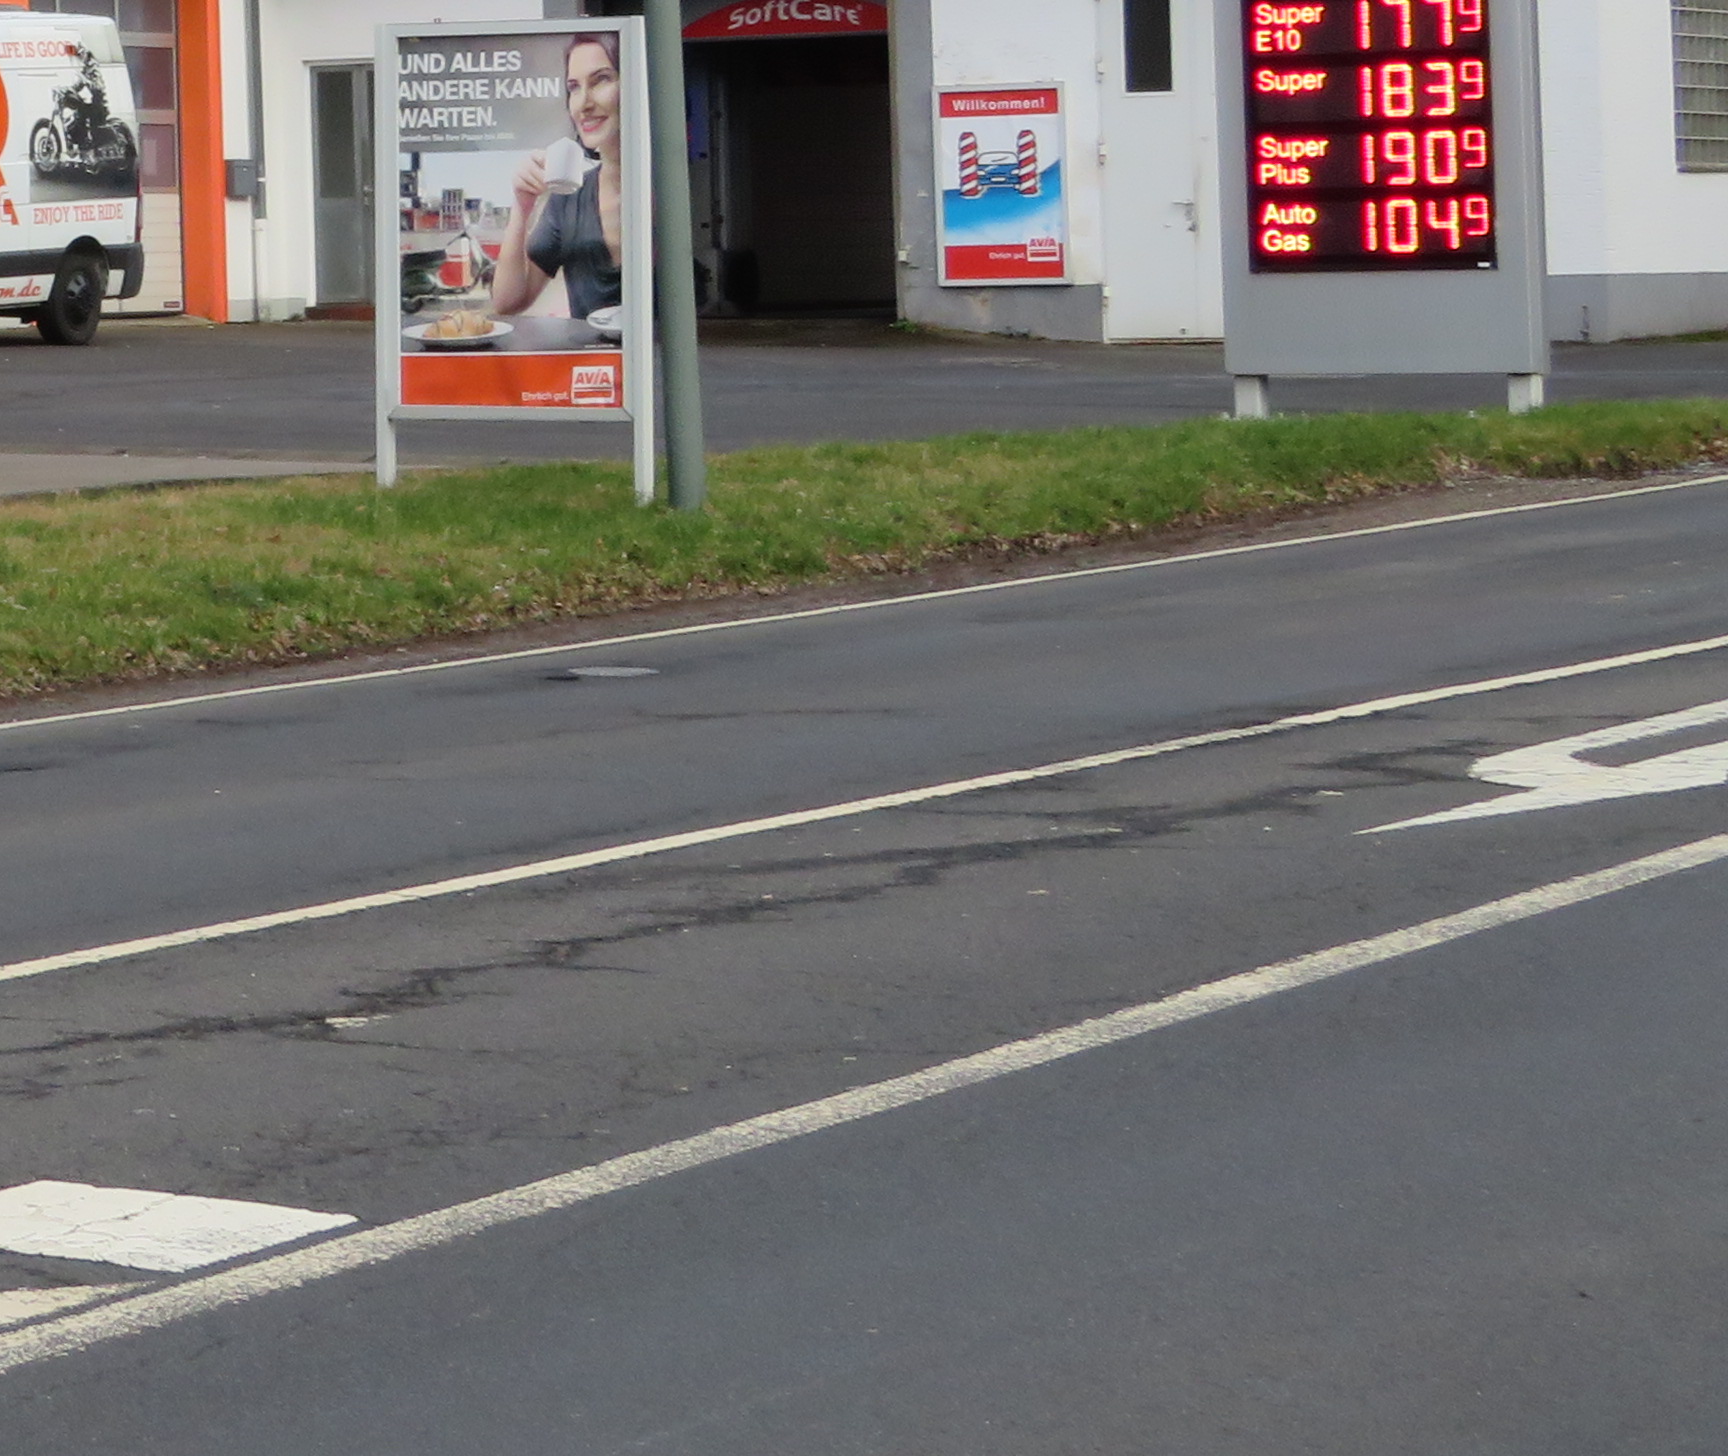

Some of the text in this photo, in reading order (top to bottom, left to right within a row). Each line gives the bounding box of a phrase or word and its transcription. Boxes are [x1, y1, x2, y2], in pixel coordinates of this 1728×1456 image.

[1254, 2, 1326, 29] Super
[24, 41, 36, 58] IS
[1254, 29, 1302, 52] E10
[399, 50, 523, 75] UND ALLES
[399, 76, 562, 102] ANDERE KANN
[1256, 69, 1328, 96] Super
[952, 96, 1045, 112] Willkommen!
[399, 105, 498, 129] WARTEN.
[1258, 136, 1330, 162] Super
[1259, 163, 1312, 185] Plus
[33, 202, 124, 225] ENJOY THE RIDE
[1261, 203, 1318, 226] Auto
[1262, 228, 1312, 252] Gas
[574, 369, 612, 385] AVIA
